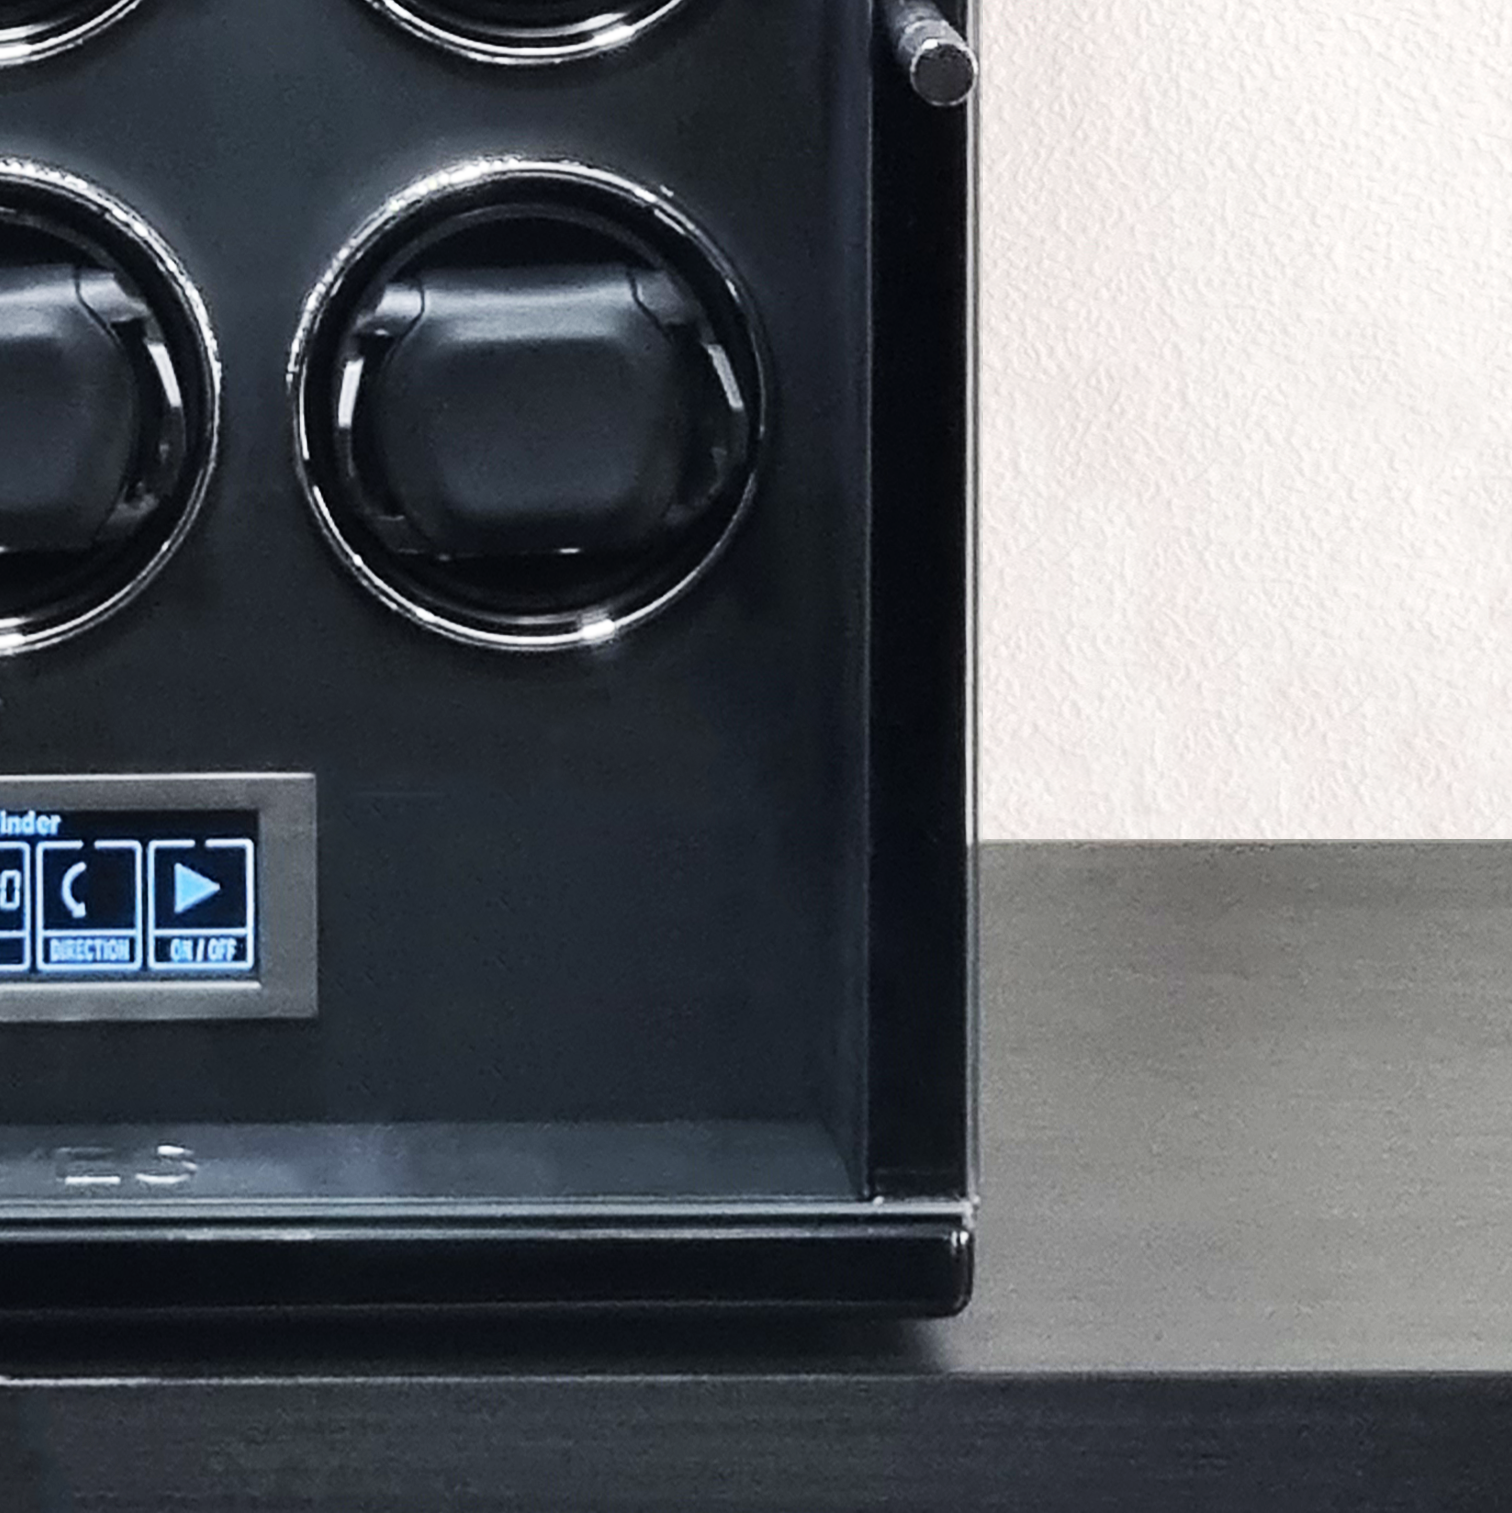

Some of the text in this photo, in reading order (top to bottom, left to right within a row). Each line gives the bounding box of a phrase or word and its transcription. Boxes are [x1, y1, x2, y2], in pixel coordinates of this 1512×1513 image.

[49, 937, 130, 963] DIRECTION
[170, 937, 194, 963] ON
[207, 937, 238, 962] OFF
